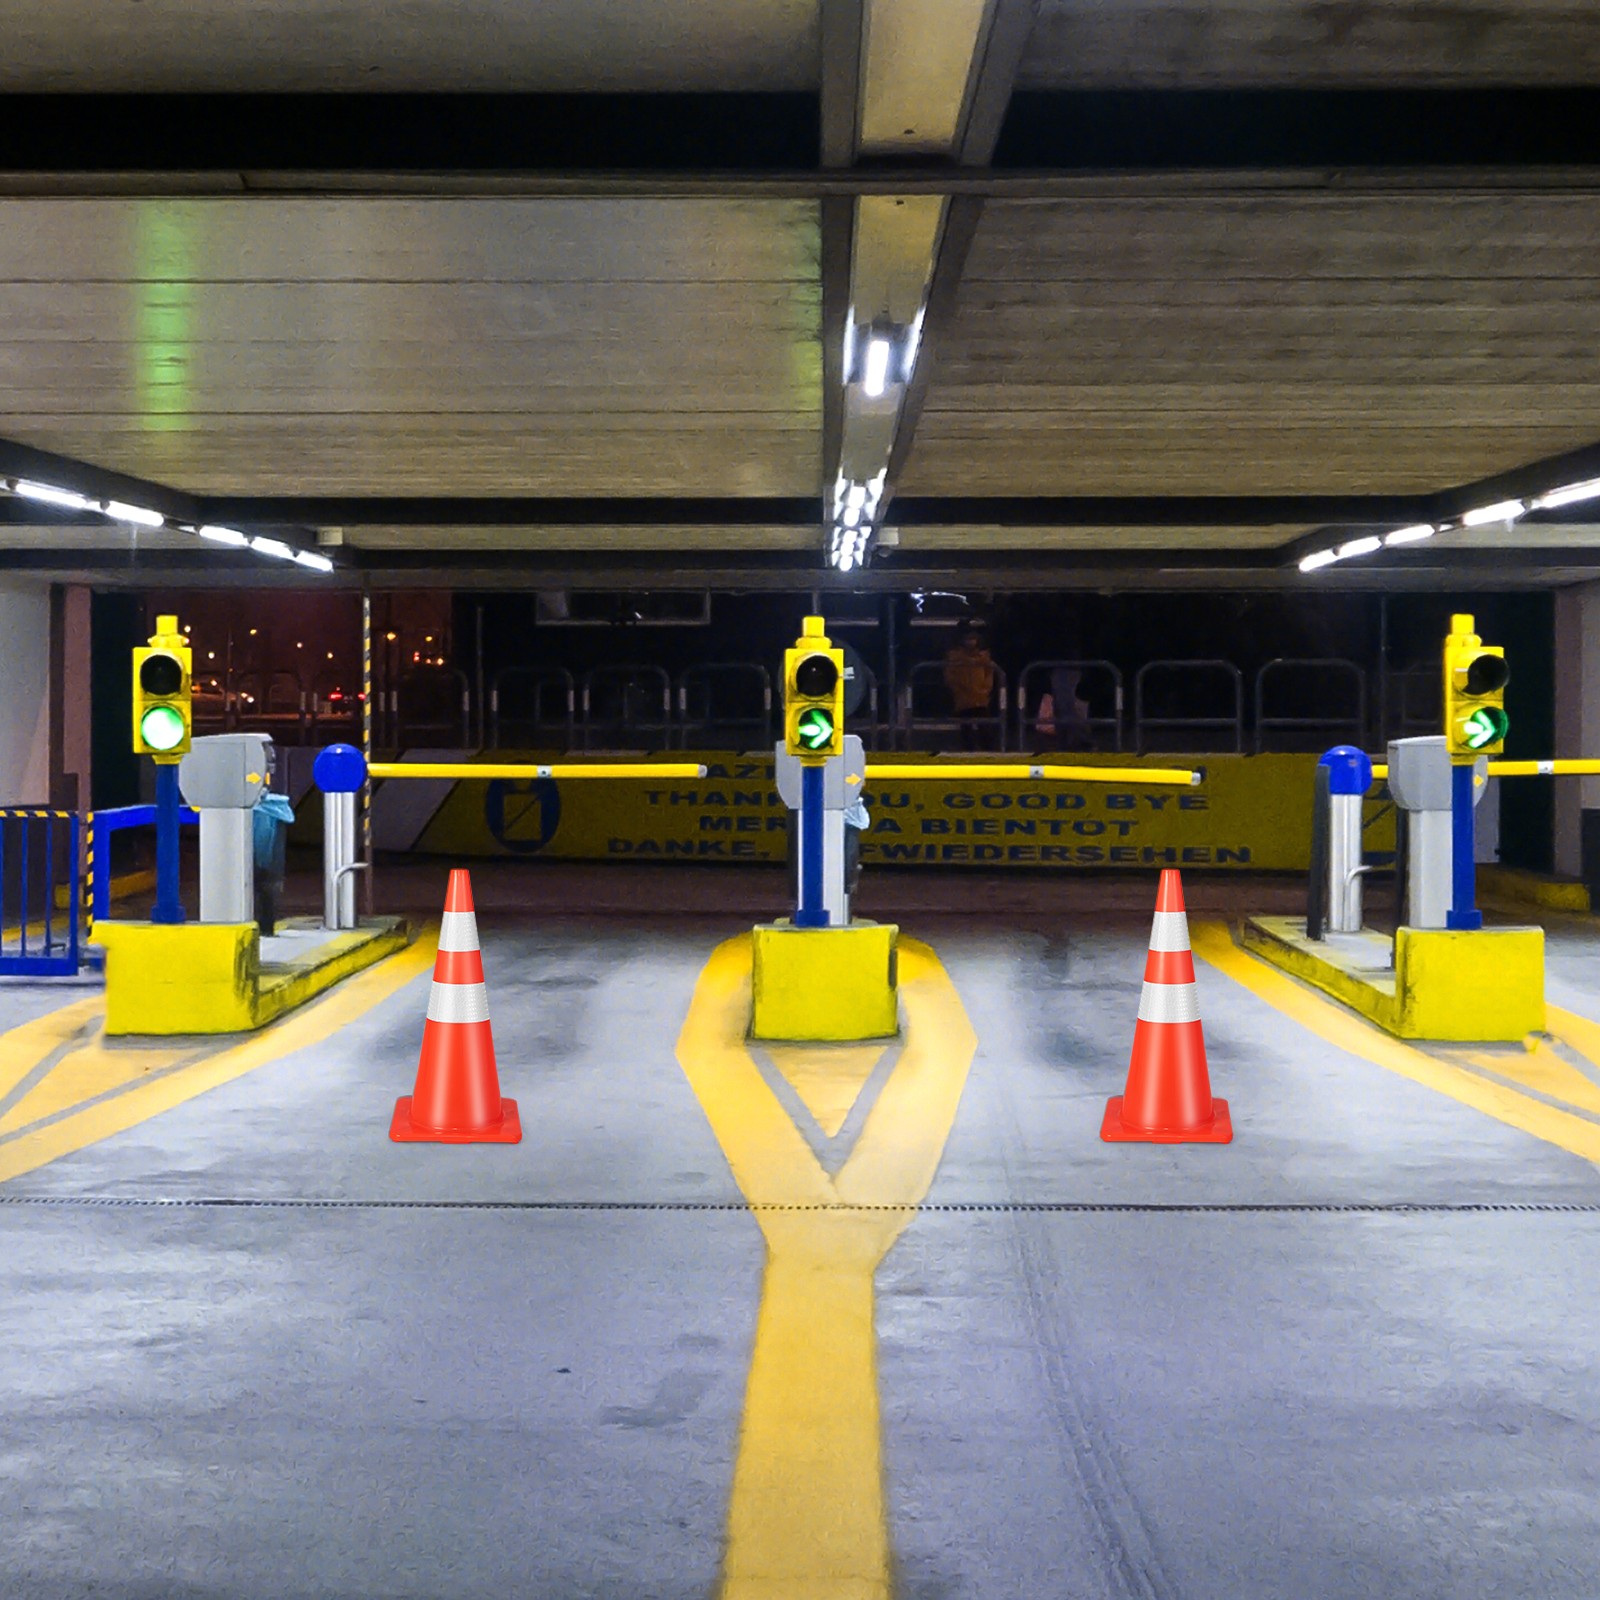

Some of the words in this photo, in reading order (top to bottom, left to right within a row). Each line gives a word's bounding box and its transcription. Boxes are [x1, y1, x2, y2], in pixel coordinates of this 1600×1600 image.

[706, 764, 776, 779] AZI
[943, 793, 1086, 809] GOOD
[1105, 794, 1208, 810] BYE
[700, 816, 787, 832] MER
[872, 818, 902, 833] A
[921, 819, 1138, 836] BIENTOT
[607, 839, 770, 858] DANKE,
[859, 843, 1250, 863] FWIEDERSEHEN
